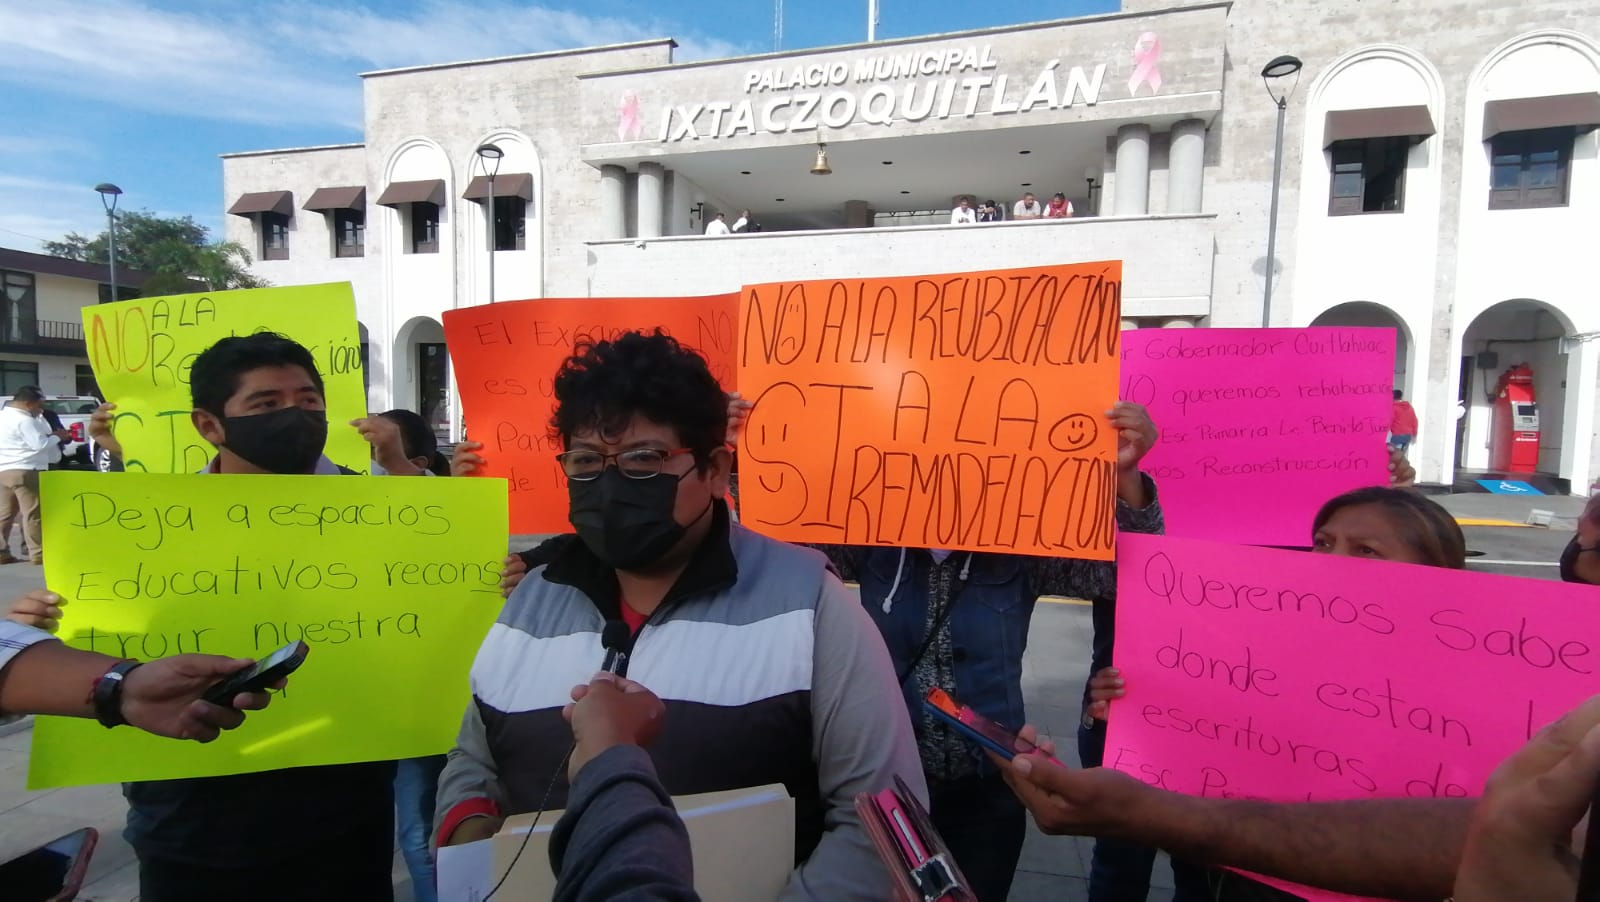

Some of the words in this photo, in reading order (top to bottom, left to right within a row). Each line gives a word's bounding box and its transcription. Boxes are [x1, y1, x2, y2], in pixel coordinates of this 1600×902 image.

[657, 60, 1108, 143] IXTACZOQUITLÁN
[743, 62, 849, 93] PALACIO
[853, 44, 997, 81] MUNICIPAL
[92, 306, 150, 373] NO
[151, 300, 170, 330] A
[178, 297, 216, 327] LA
[743, 283, 808, 367] NO
[1145, 336, 1284, 361] Gobernador
[893, 370, 931, 444] A
[954, 374, 1040, 451] LA
[1172, 384, 1281, 416] queremos
[844, 445, 1117, 553] REMODELACIÓN
[1196, 452, 1369, 478] Reconstrucción
[72, 491, 194, 551] Deja
[227, 501, 252, 529] a
[268, 495, 452, 537] espacios
[76, 555, 359, 602] Educativos
[384, 558, 502, 590] recons
[1144, 551, 1396, 635] Queremos
[254, 611, 422, 651] nuestra
[1155, 627, 1280, 697] donde
[1315, 678, 1473, 747] estan
[1142, 703, 1378, 793] escrituras
